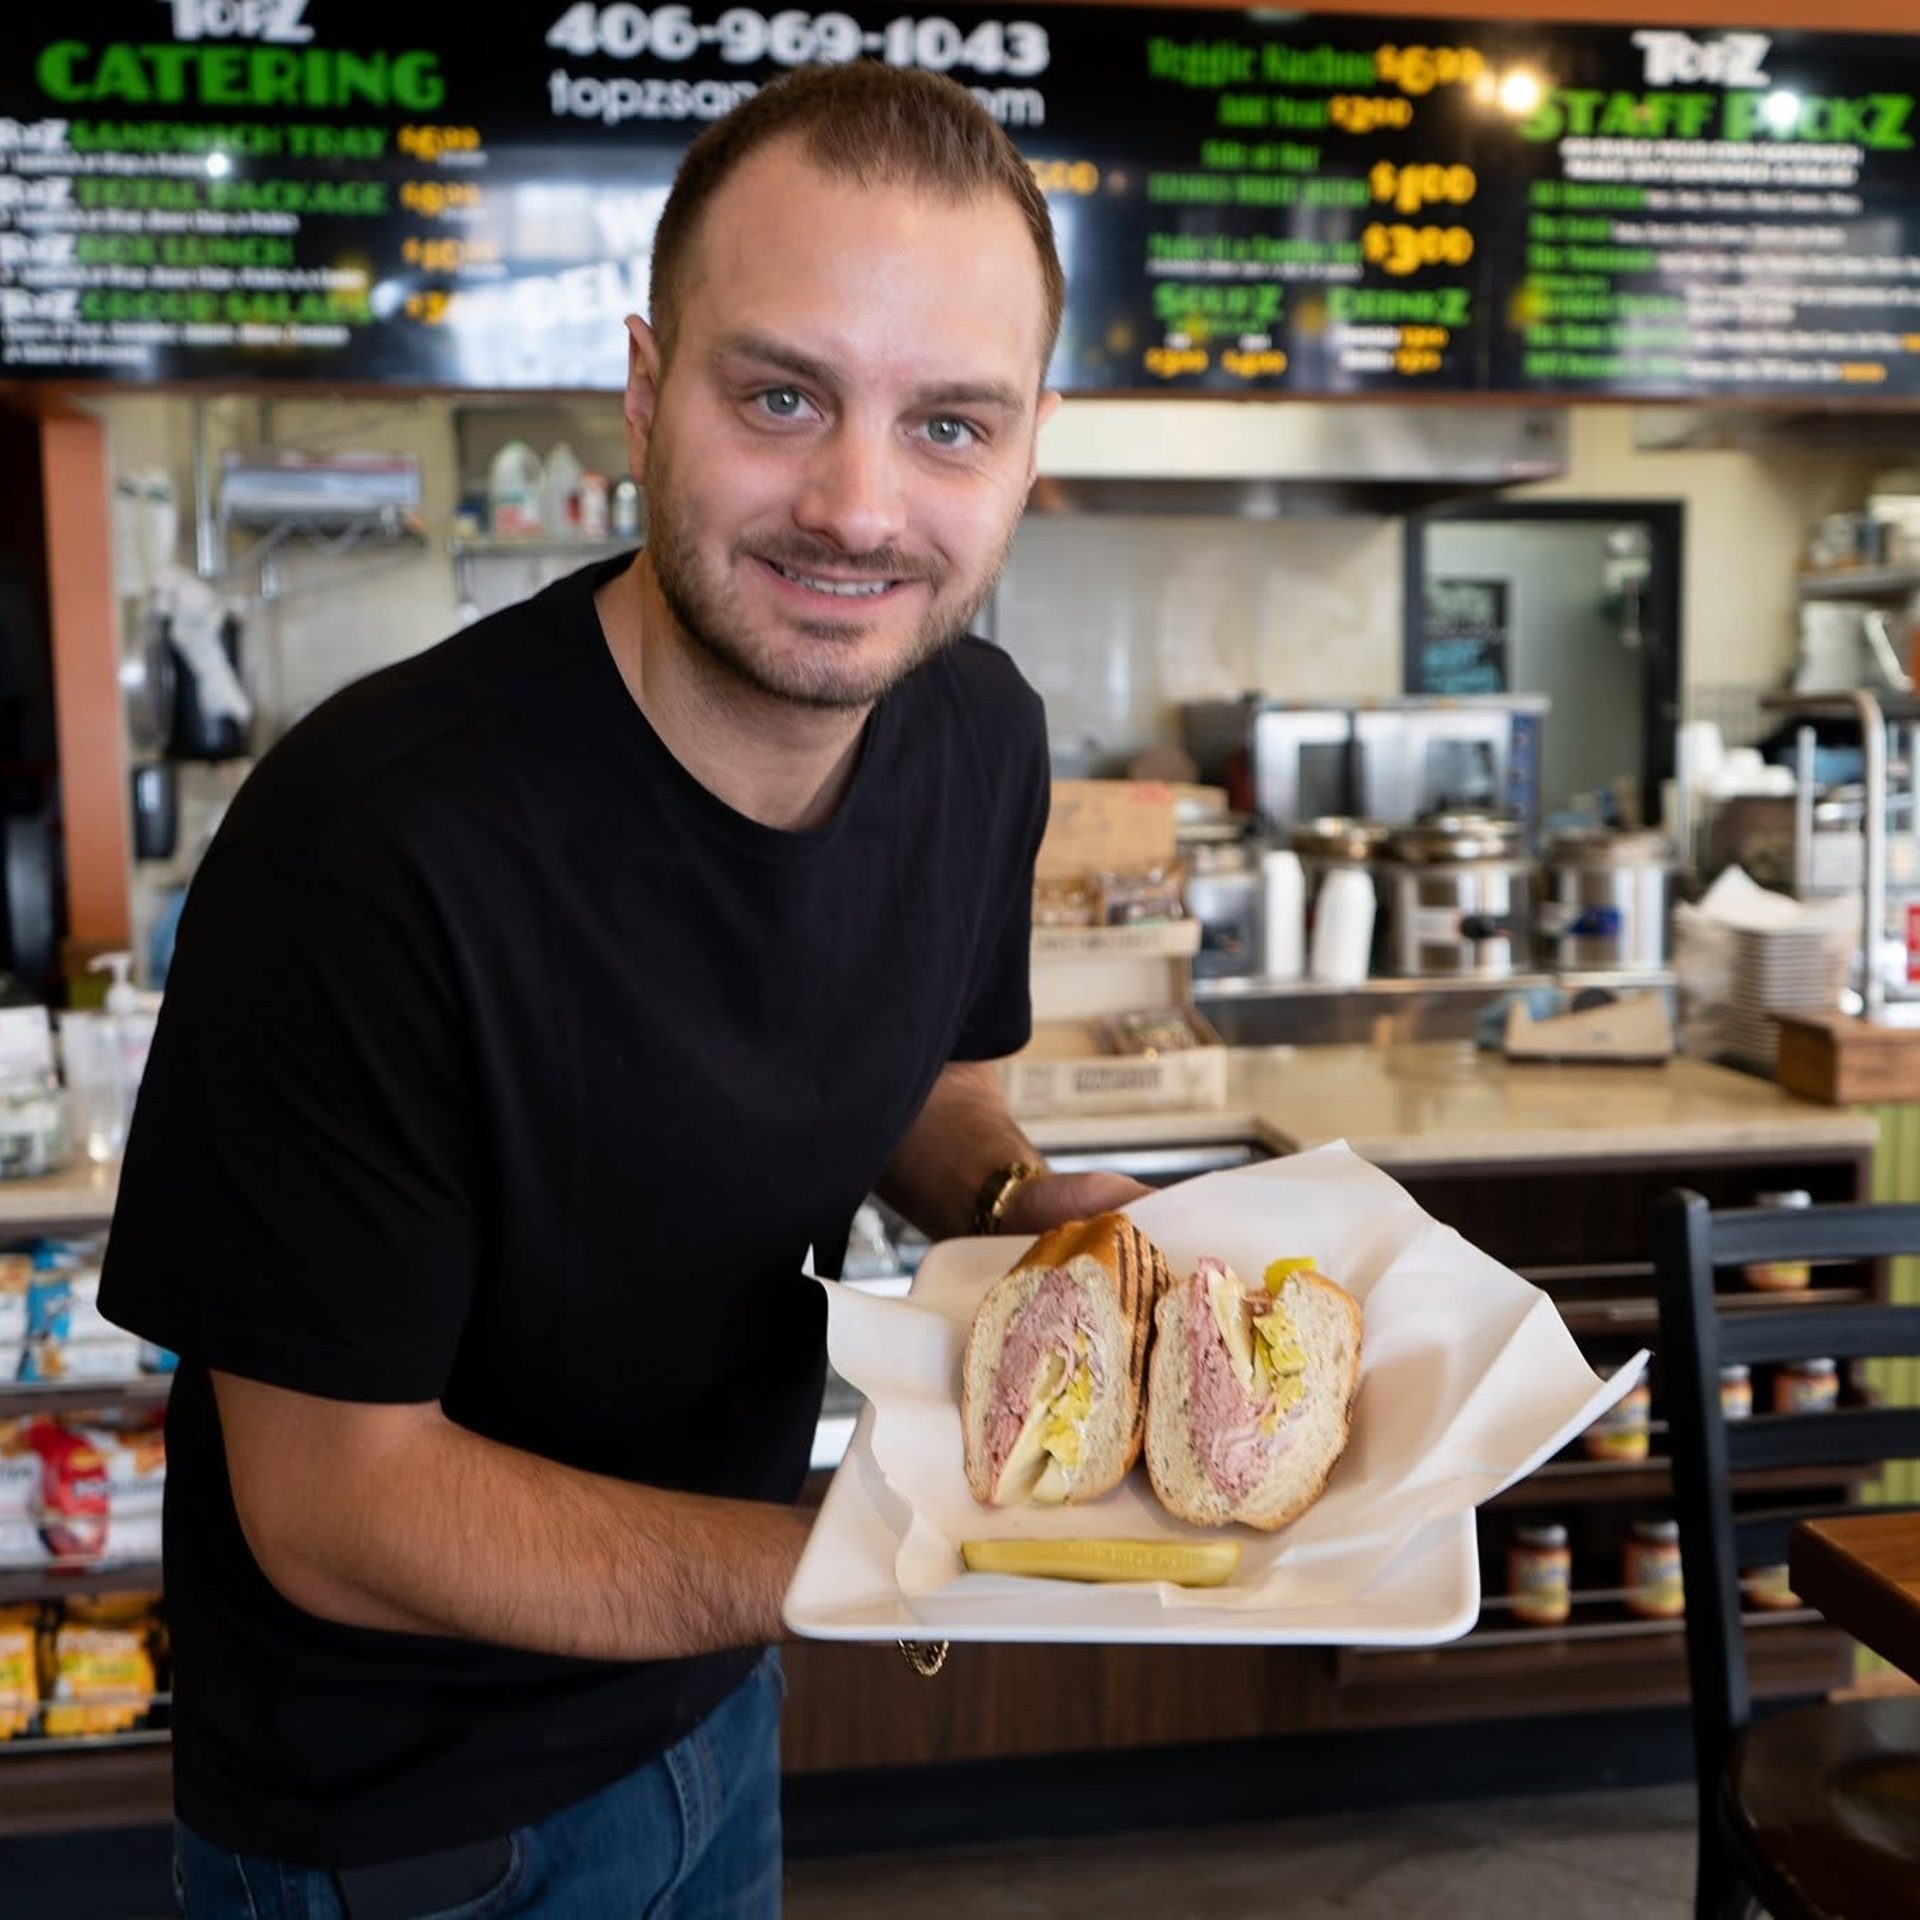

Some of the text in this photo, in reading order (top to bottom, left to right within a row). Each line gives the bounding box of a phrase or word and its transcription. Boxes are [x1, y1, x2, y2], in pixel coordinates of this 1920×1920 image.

[545, 1, 1051, 77] 406-969-1043
[35, 39, 446, 111] CATERING
[287, 124, 388, 158] TRAY
[1518, 89, 1913, 149] STAFF PCKZ
